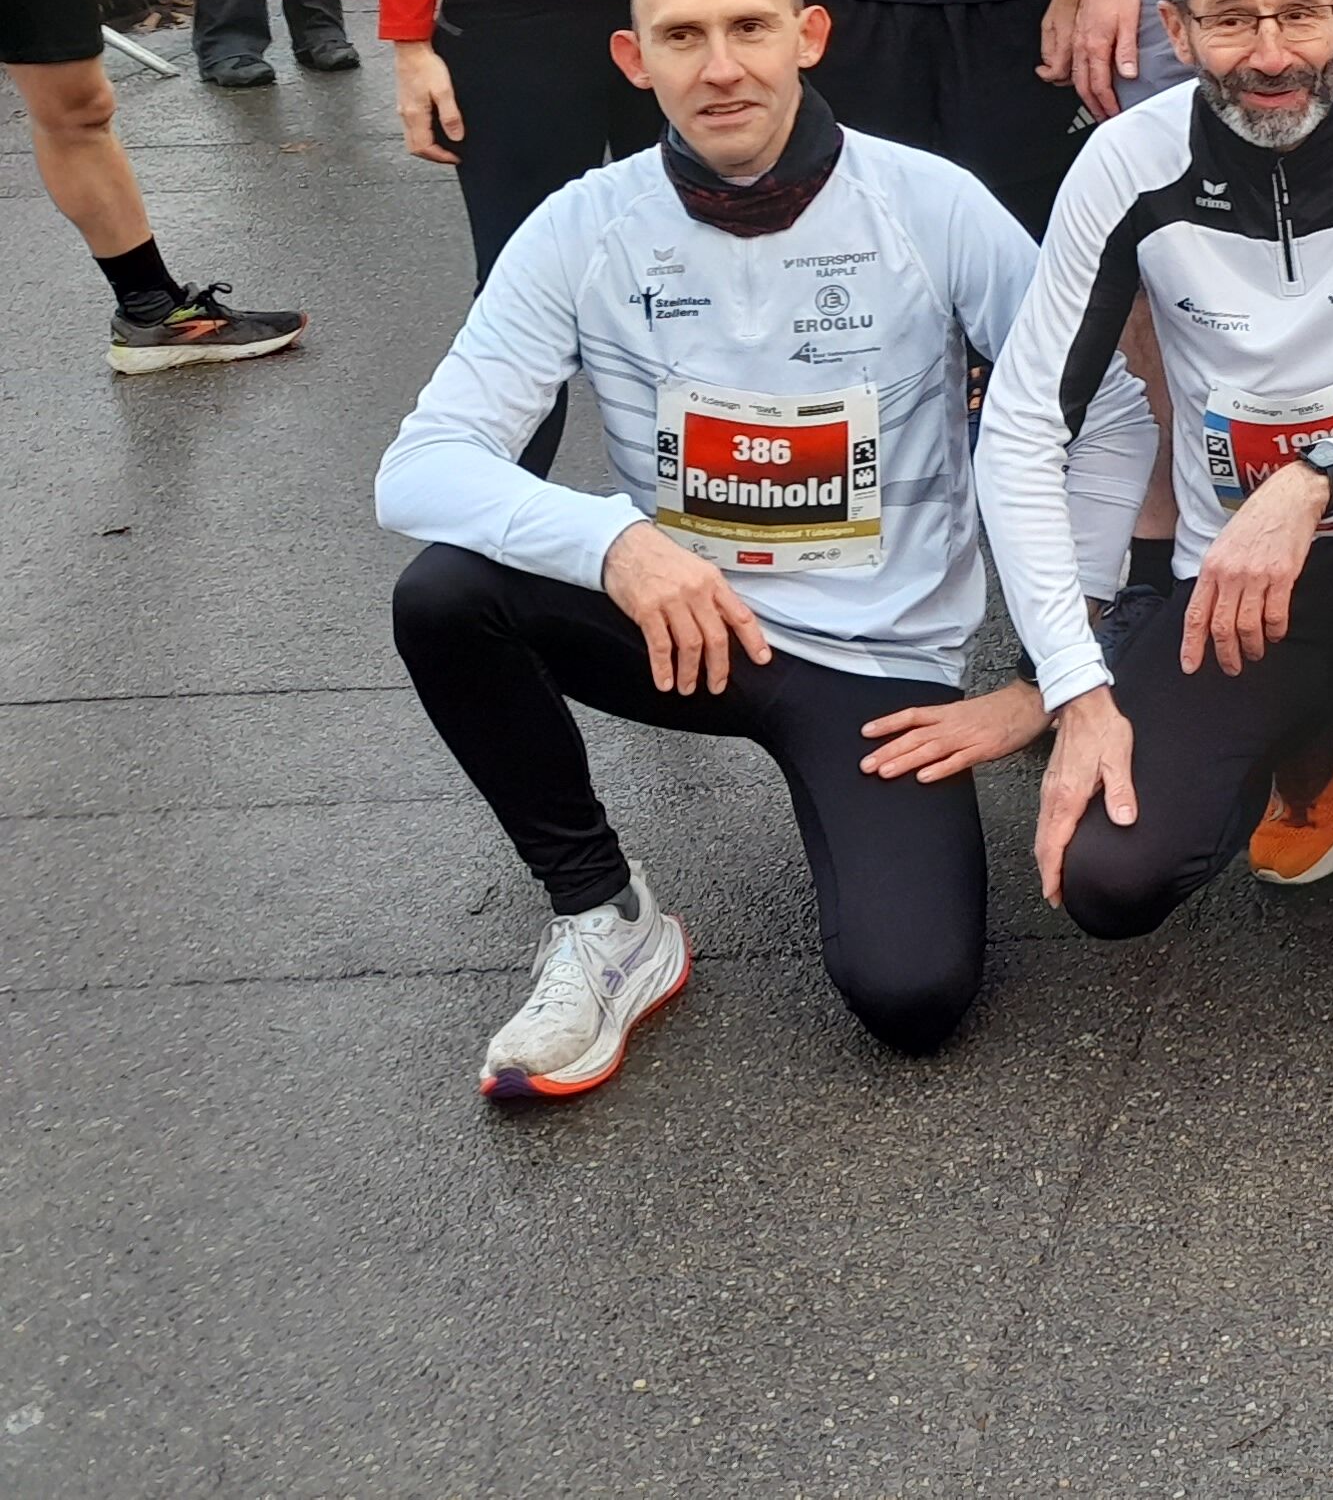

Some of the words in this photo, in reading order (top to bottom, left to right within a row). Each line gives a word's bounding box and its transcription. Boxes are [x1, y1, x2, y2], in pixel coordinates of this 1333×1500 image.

[1195, 196, 1232, 211] erima
[796, 251, 878, 268] INTERSPORT
[815, 266, 857, 278] RÄPPLE
[793, 314, 874, 334] EROGLU
[1191, 314, 1251, 332] MeTraVit
[731, 434, 793, 465] 386
[685, 467, 843, 509] Reinhold
[797, 550, 826, 561] AOK
